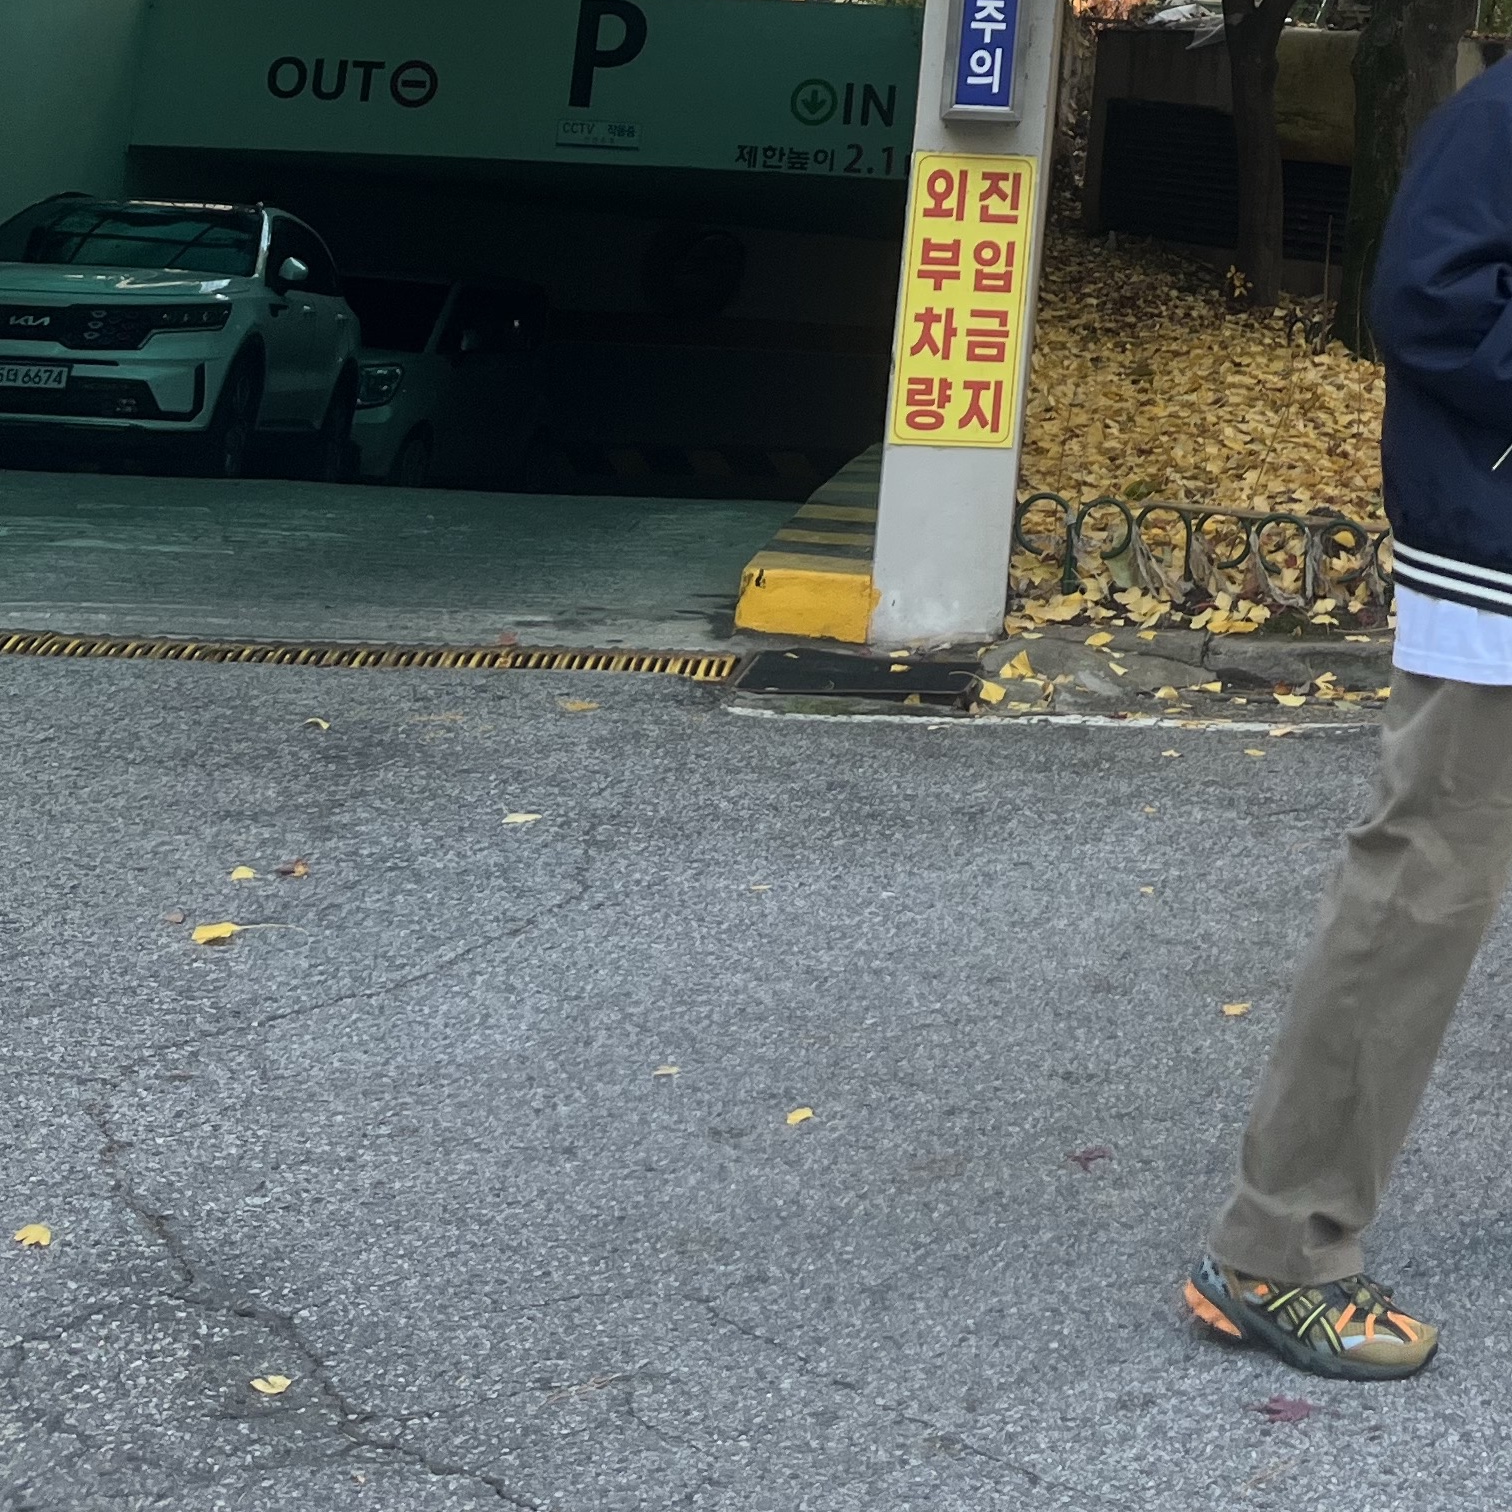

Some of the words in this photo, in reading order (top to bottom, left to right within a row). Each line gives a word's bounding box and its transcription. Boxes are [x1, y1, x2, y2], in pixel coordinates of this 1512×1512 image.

[267, 56, 386, 102] OUT
[842, 82, 897, 127] IN
[562, 121, 595, 135] CCTV
[735, 144, 835, 172] 제한높이
[903, 168, 967, 432] 외부차량
[957, 169, 1020, 434] 진입금지
[21, 368, 64, 385] 6674
